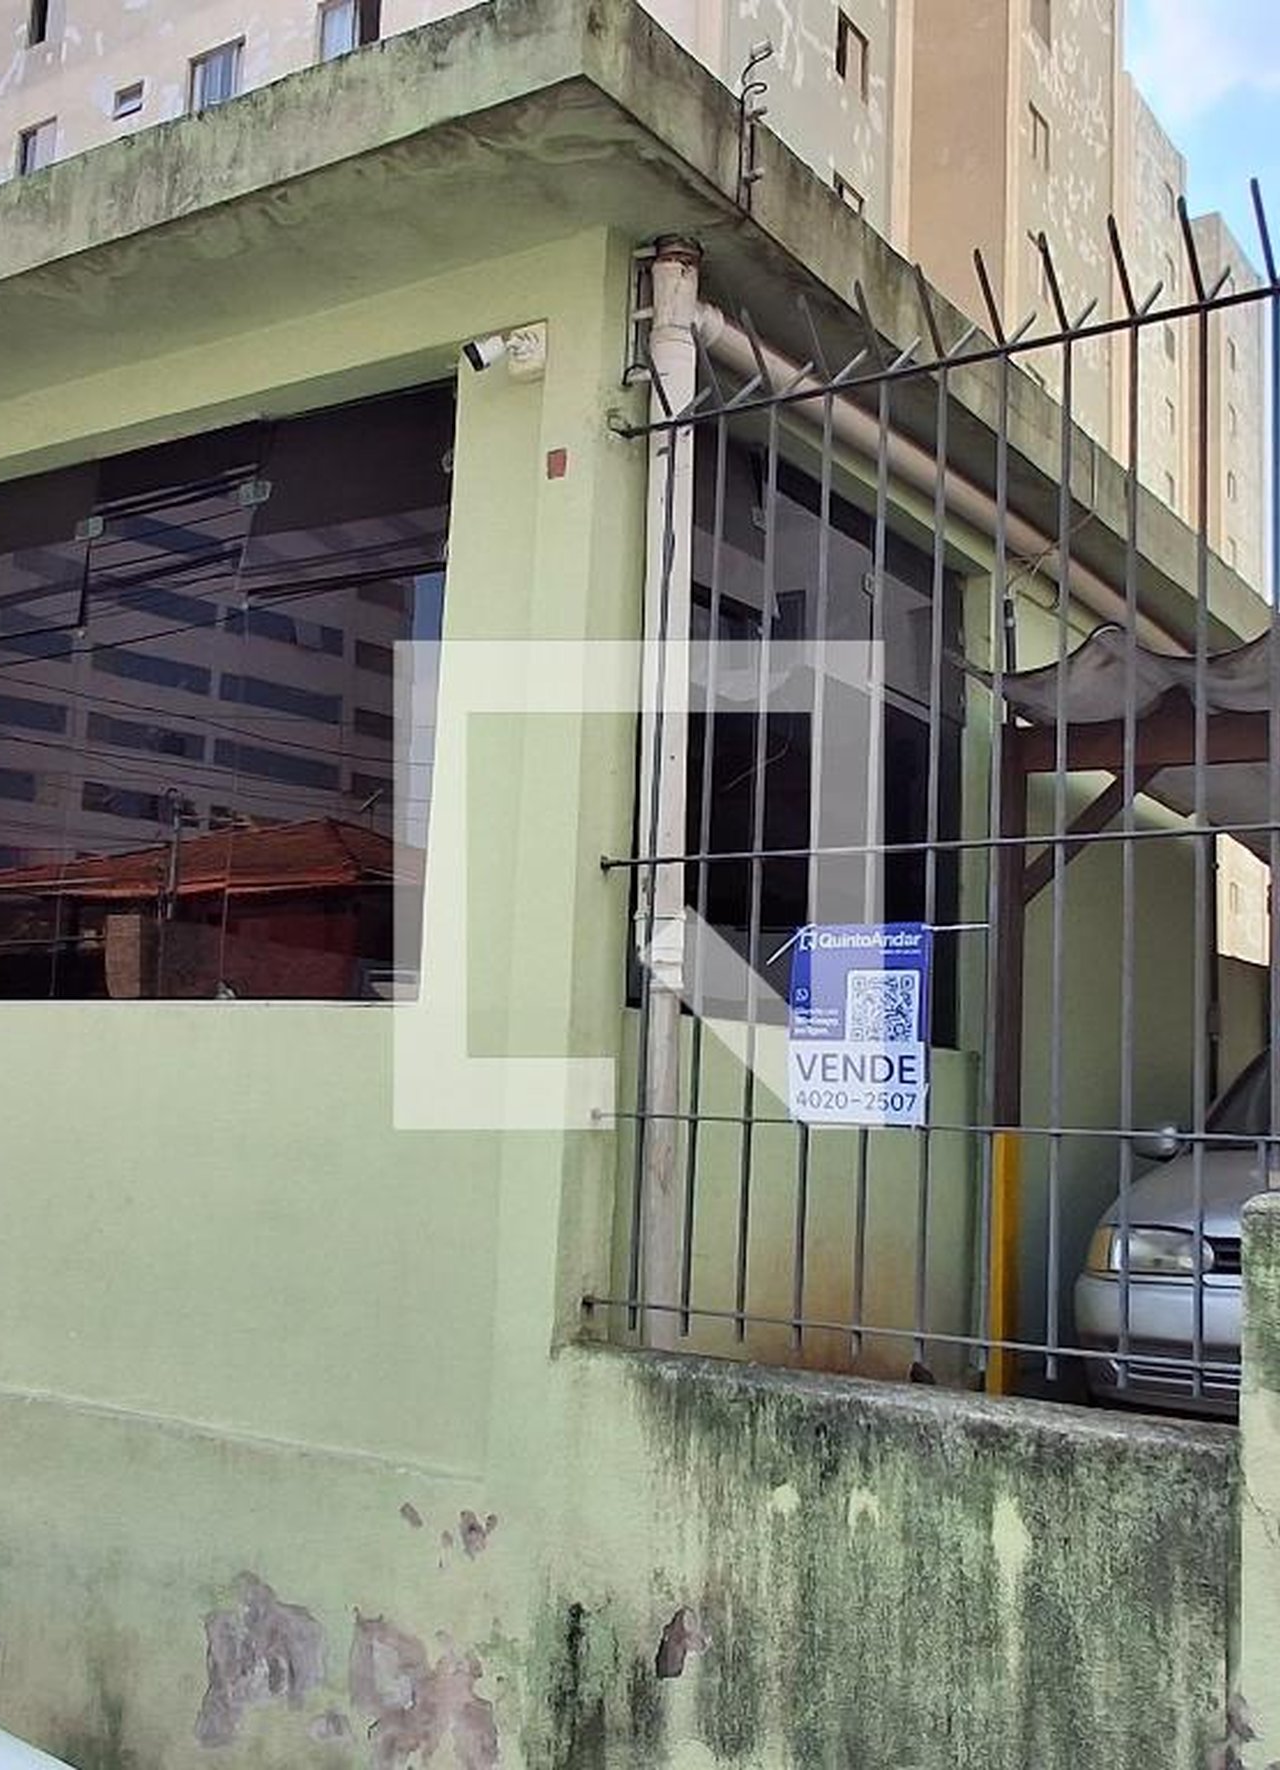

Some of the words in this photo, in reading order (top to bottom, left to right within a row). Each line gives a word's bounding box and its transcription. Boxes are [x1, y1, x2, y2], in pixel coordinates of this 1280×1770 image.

[819, 931, 923, 950] QuintoAndar
[797, 1053, 919, 1085] VENDE
[796, 1089, 918, 1112] 4020-2507
